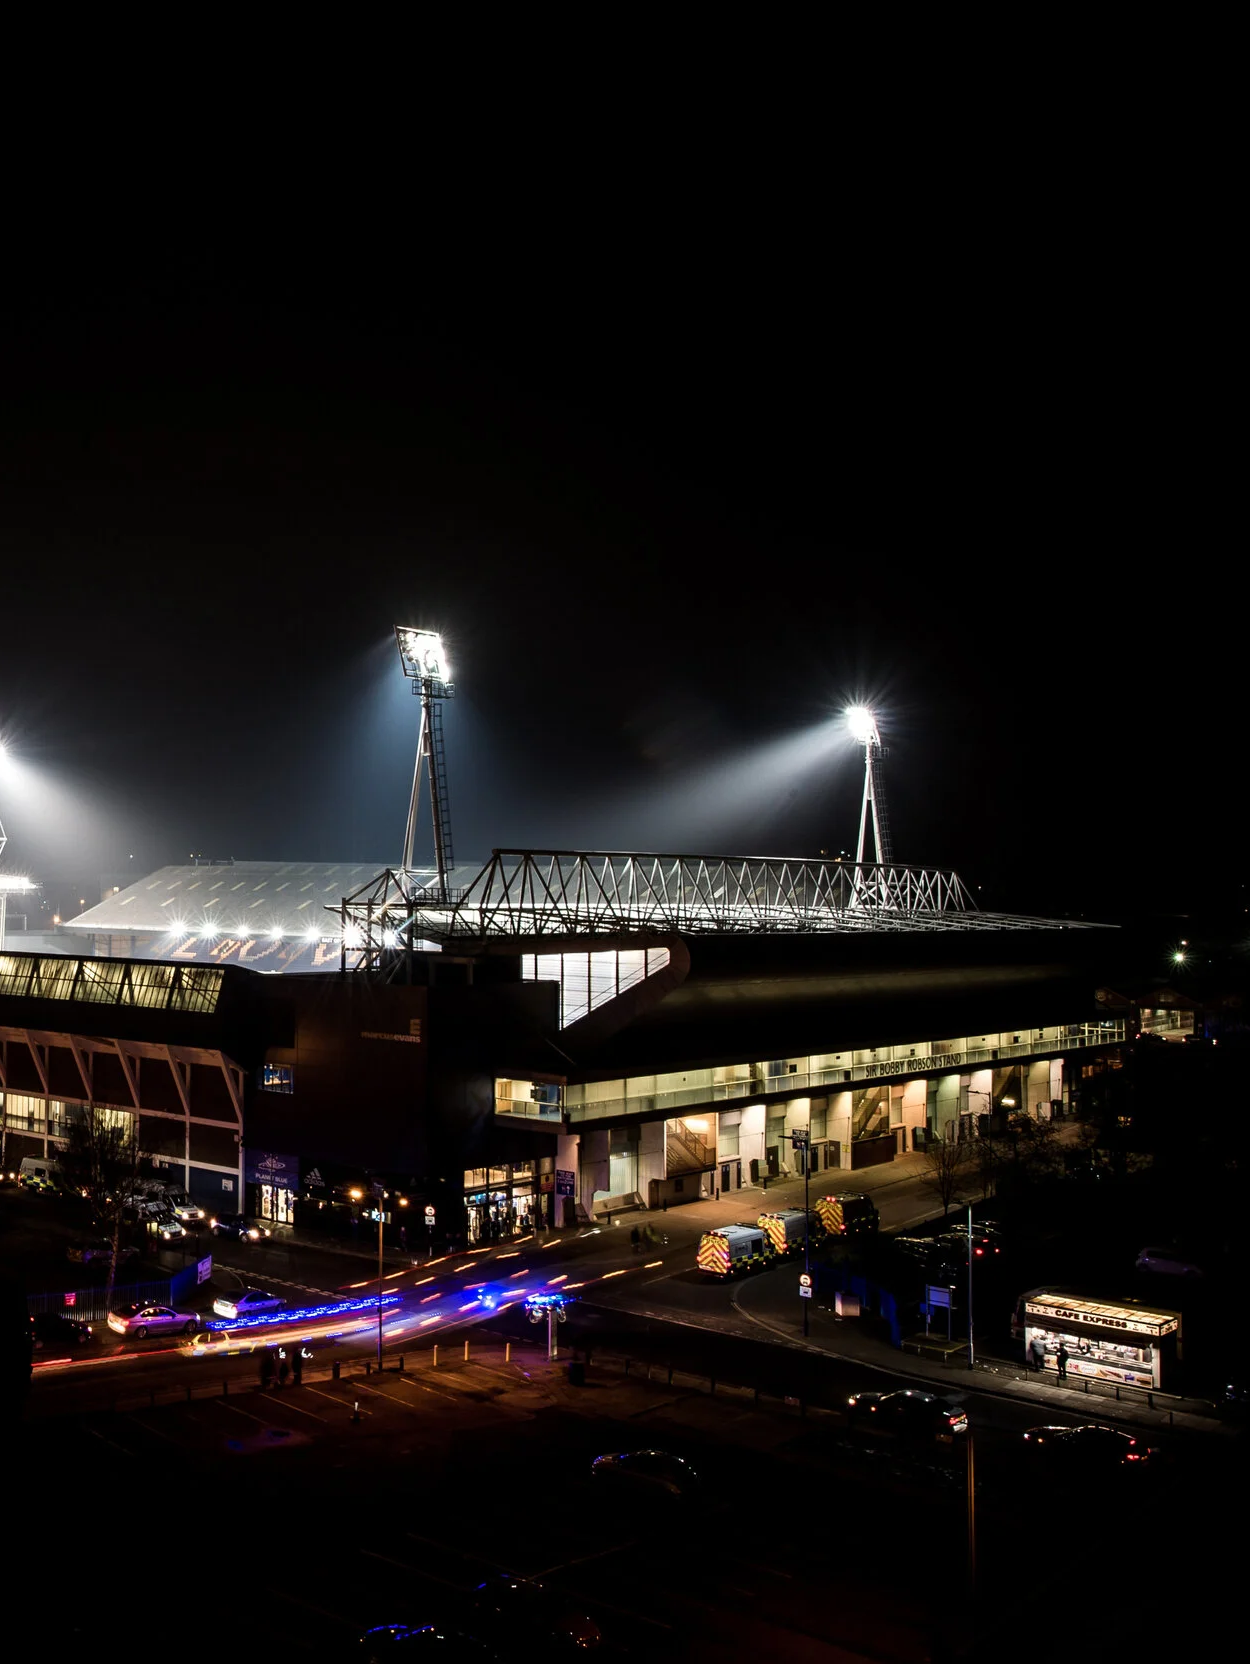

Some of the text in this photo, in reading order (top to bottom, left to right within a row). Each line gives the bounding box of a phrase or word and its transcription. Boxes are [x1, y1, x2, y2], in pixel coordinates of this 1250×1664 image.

[866, 1053, 961, 1077] SIR BOBBY ROBSON STAND
[1055, 1309, 1080, 1320] CAFE
[1083, 1315, 1128, 1328] EXPRESS
